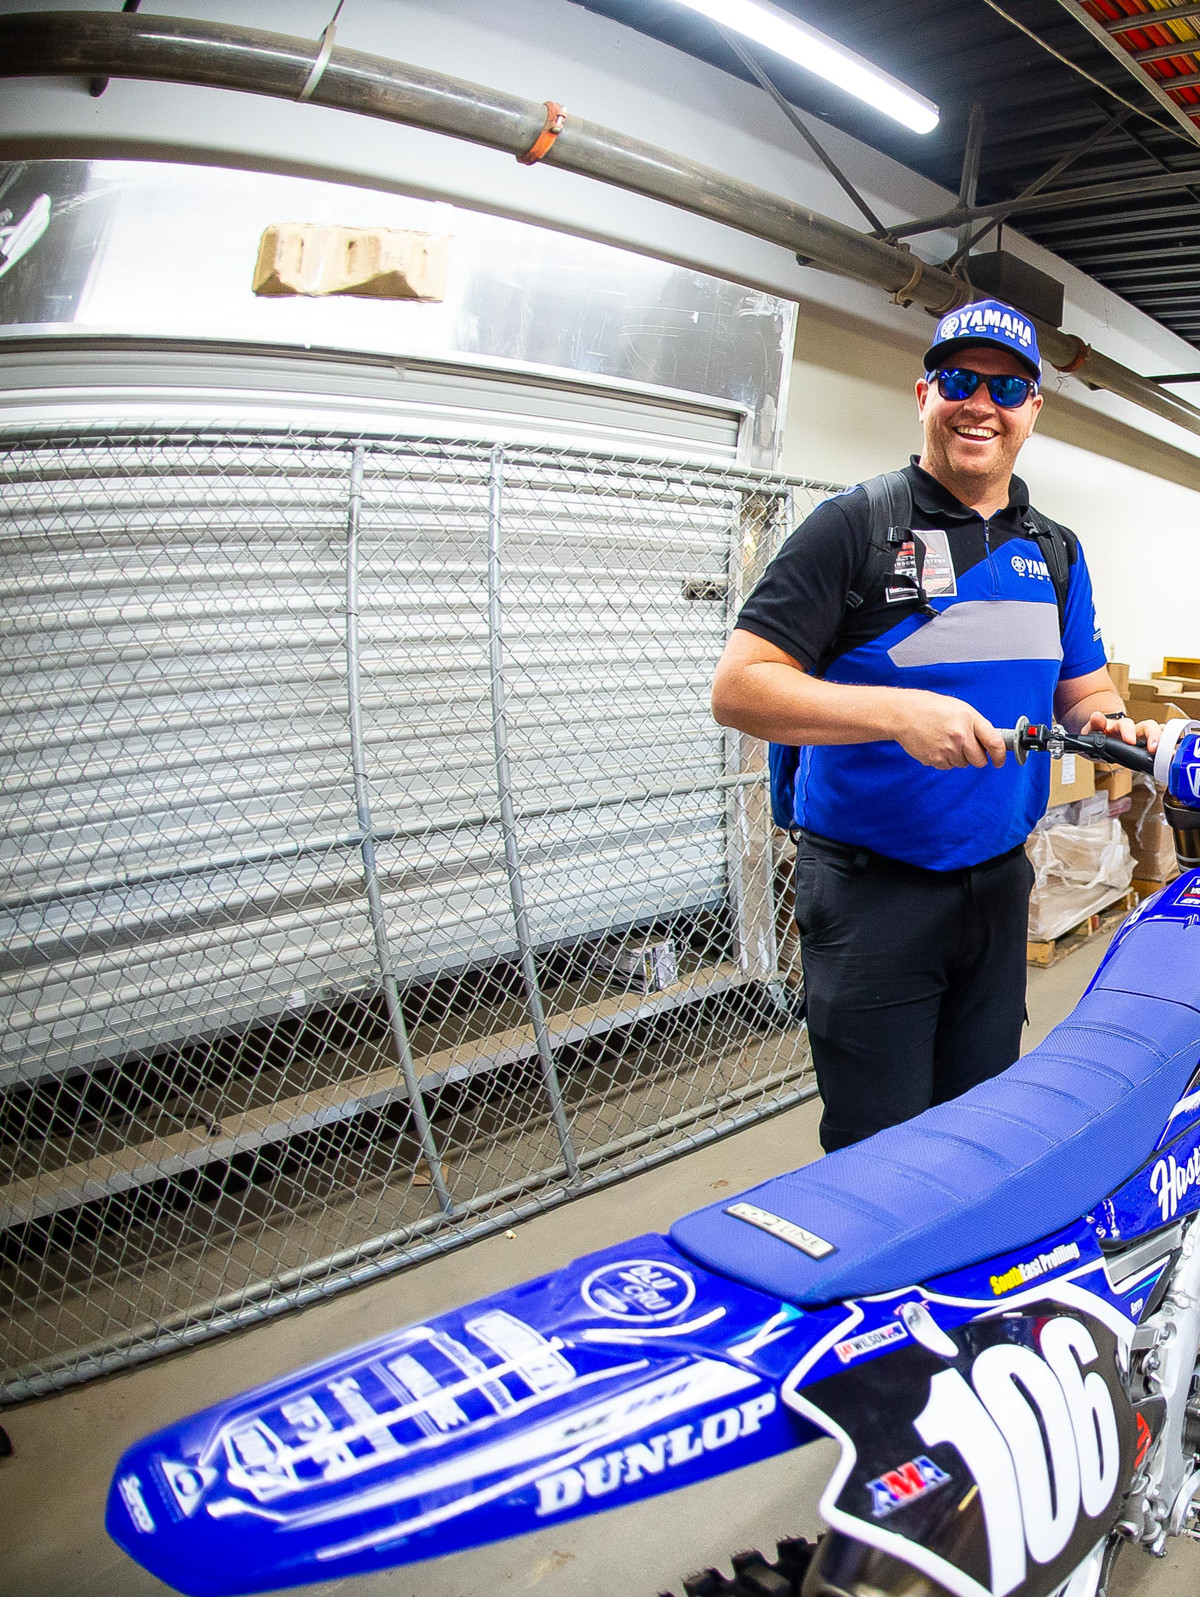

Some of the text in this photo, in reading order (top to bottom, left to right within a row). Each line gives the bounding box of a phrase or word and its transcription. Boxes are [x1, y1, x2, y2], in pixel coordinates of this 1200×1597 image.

[959, 309, 1032, 345] YAMAHA
[1025, 558, 1051, 577] YAM
[629, 1265, 678, 1290] BLU
[852, 1331, 888, 1351] WILSON
[535, 1392, 777, 1517] DUNLOP
[913, 1316, 1120, 1597] 106
[866, 1454, 952, 1518] AMA
